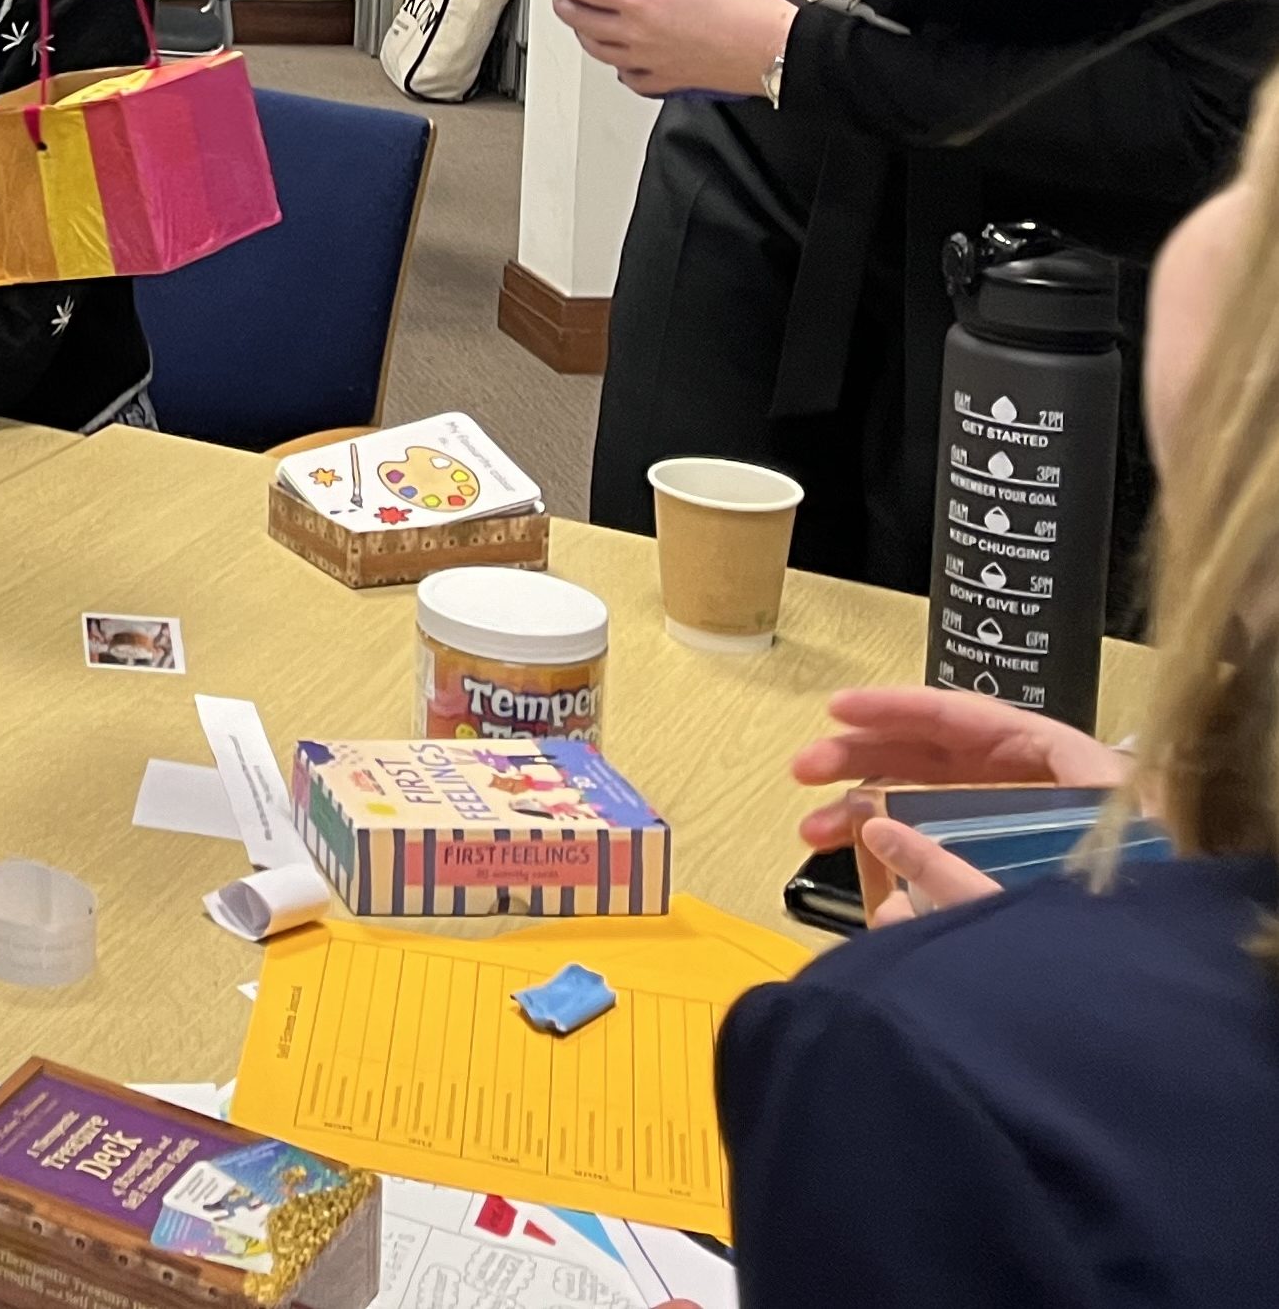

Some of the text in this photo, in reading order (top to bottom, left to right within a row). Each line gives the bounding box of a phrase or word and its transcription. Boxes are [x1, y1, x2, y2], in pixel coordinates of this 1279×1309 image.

[961, 419, 1049, 448] GET STARTED
[1036, 465, 1061, 484] 3PM
[998, 487, 1027, 503] YOUR
[1028, 492, 1058, 507] GOAL
[949, 527, 1051, 562] KEEP CHUGGING
[1034, 520, 1057, 539] 4PM
[949, 582, 1041, 616] DON'T GIVE UP
[1030, 575, 1054, 596] 5PM
[945, 638, 1039, 673] ALMOST THERE
[462, 677, 603, 728] Temper
[1022, 685, 1045, 704] 7PM
[374, 756, 442, 805] FIRST
[408, 743, 500, 822] FEELINGS
[443, 845, 591, 866] FIRST FEELINGS
[41, 1114, 109, 1170] Treasure
[75, 1130, 143, 1180] Deck
